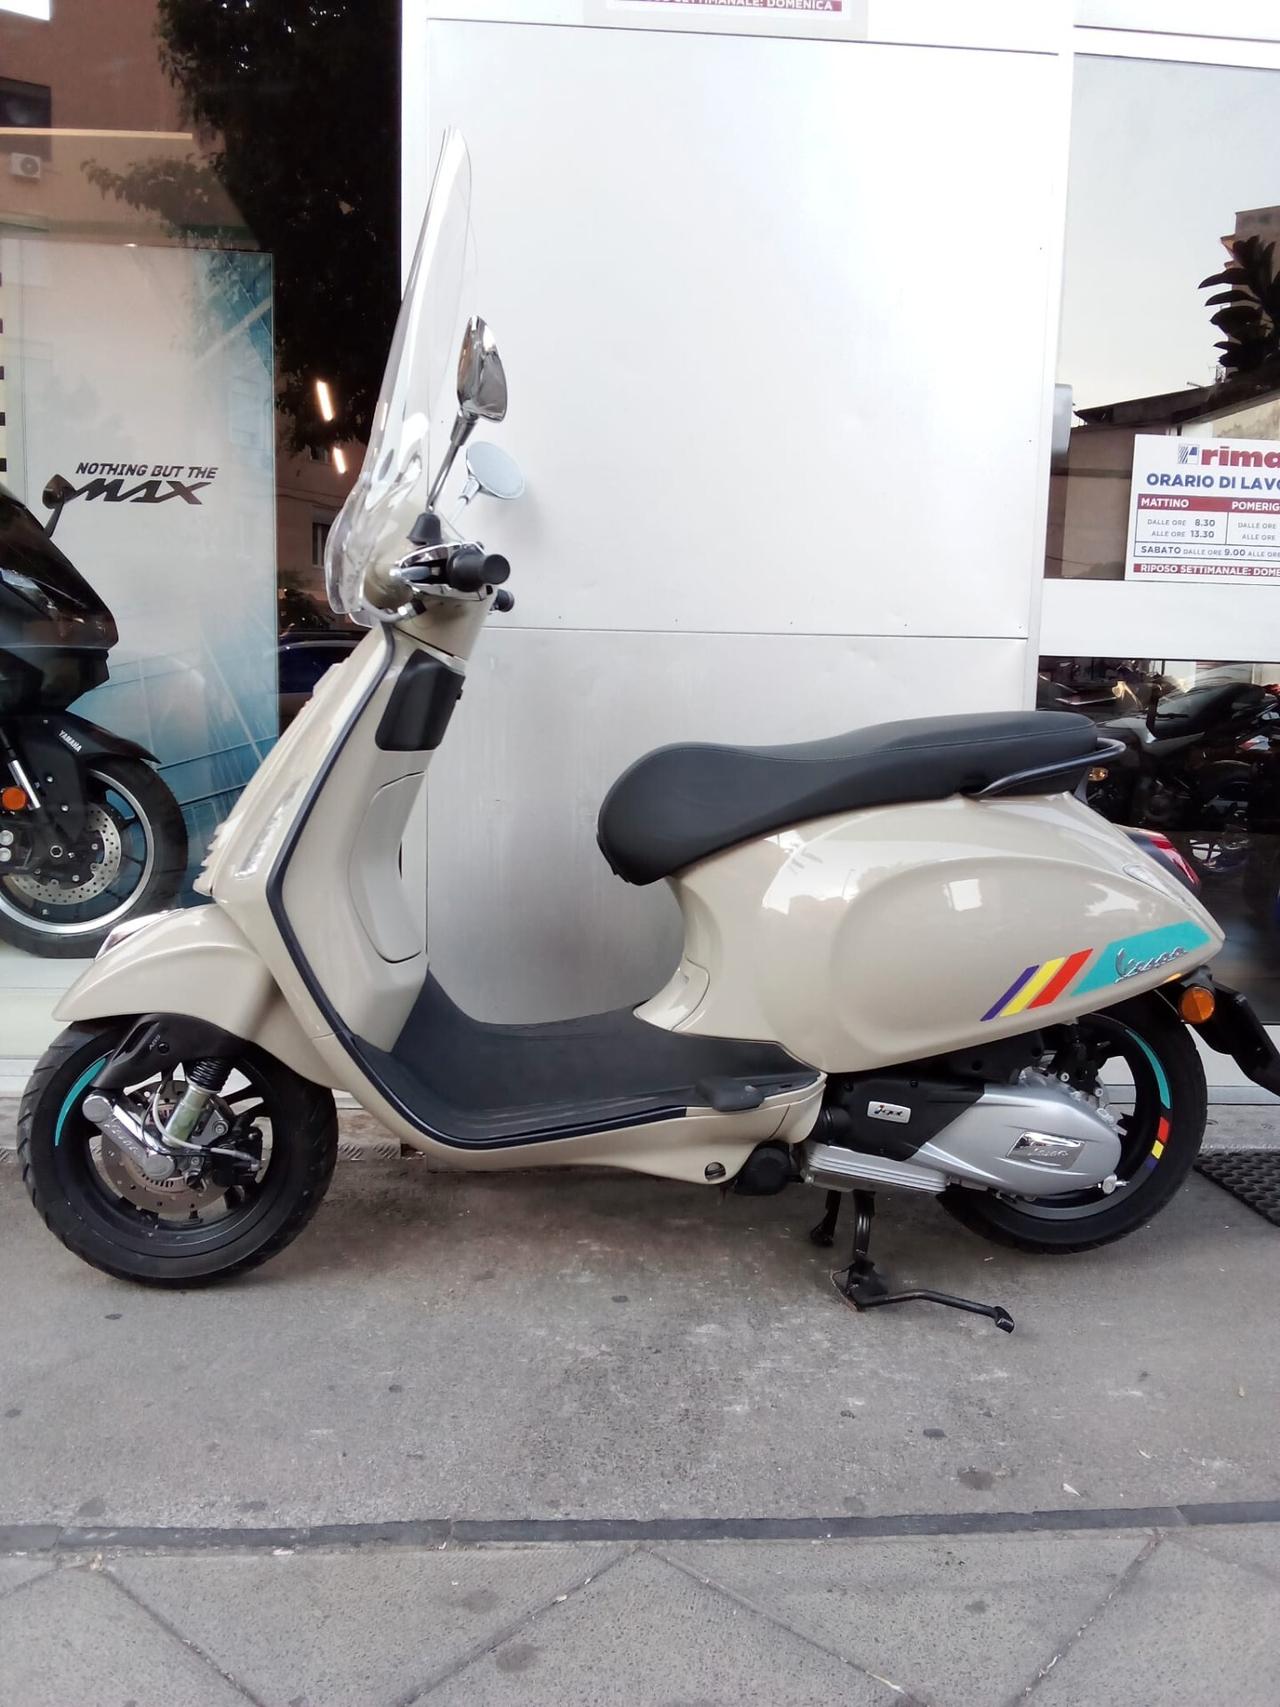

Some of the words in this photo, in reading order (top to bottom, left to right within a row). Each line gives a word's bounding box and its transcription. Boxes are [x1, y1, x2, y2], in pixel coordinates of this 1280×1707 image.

[766, 0, 833, 10] DOMENICA
[75, 462, 148, 477] NOTHING
[150, 465, 184, 478] BUT
[187, 466, 218, 479] THE
[1146, 473, 1214, 488] ORARIO
[1219, 475, 1236, 489] DI
[1241, 476, 1280, 491] LAV
[65, 478, 212, 505] MAX
[1140, 498, 1189, 508] MATTINO
[1147, 518, 1169, 526] DALLE
[1171, 519, 1187, 527] ORE
[1194, 518, 1216, 527] 8.30
[1262, 522, 1277, 530] ORE
[1170, 530, 1186, 538] ORE
[1190, 530, 1215, 539] 13.30
[1140, 545, 1181, 555] SABATO
[1183, 548, 1205, 556] DALLE
[1207, 548, 1222, 556] ORE
[1224, 548, 1246, 557] 9.00
[1140, 564, 1178, 573] RIPOSO
[1180, 565, 1252, 575] SETTIMANALE:
[58, 729, 82, 752] YAMAHA
